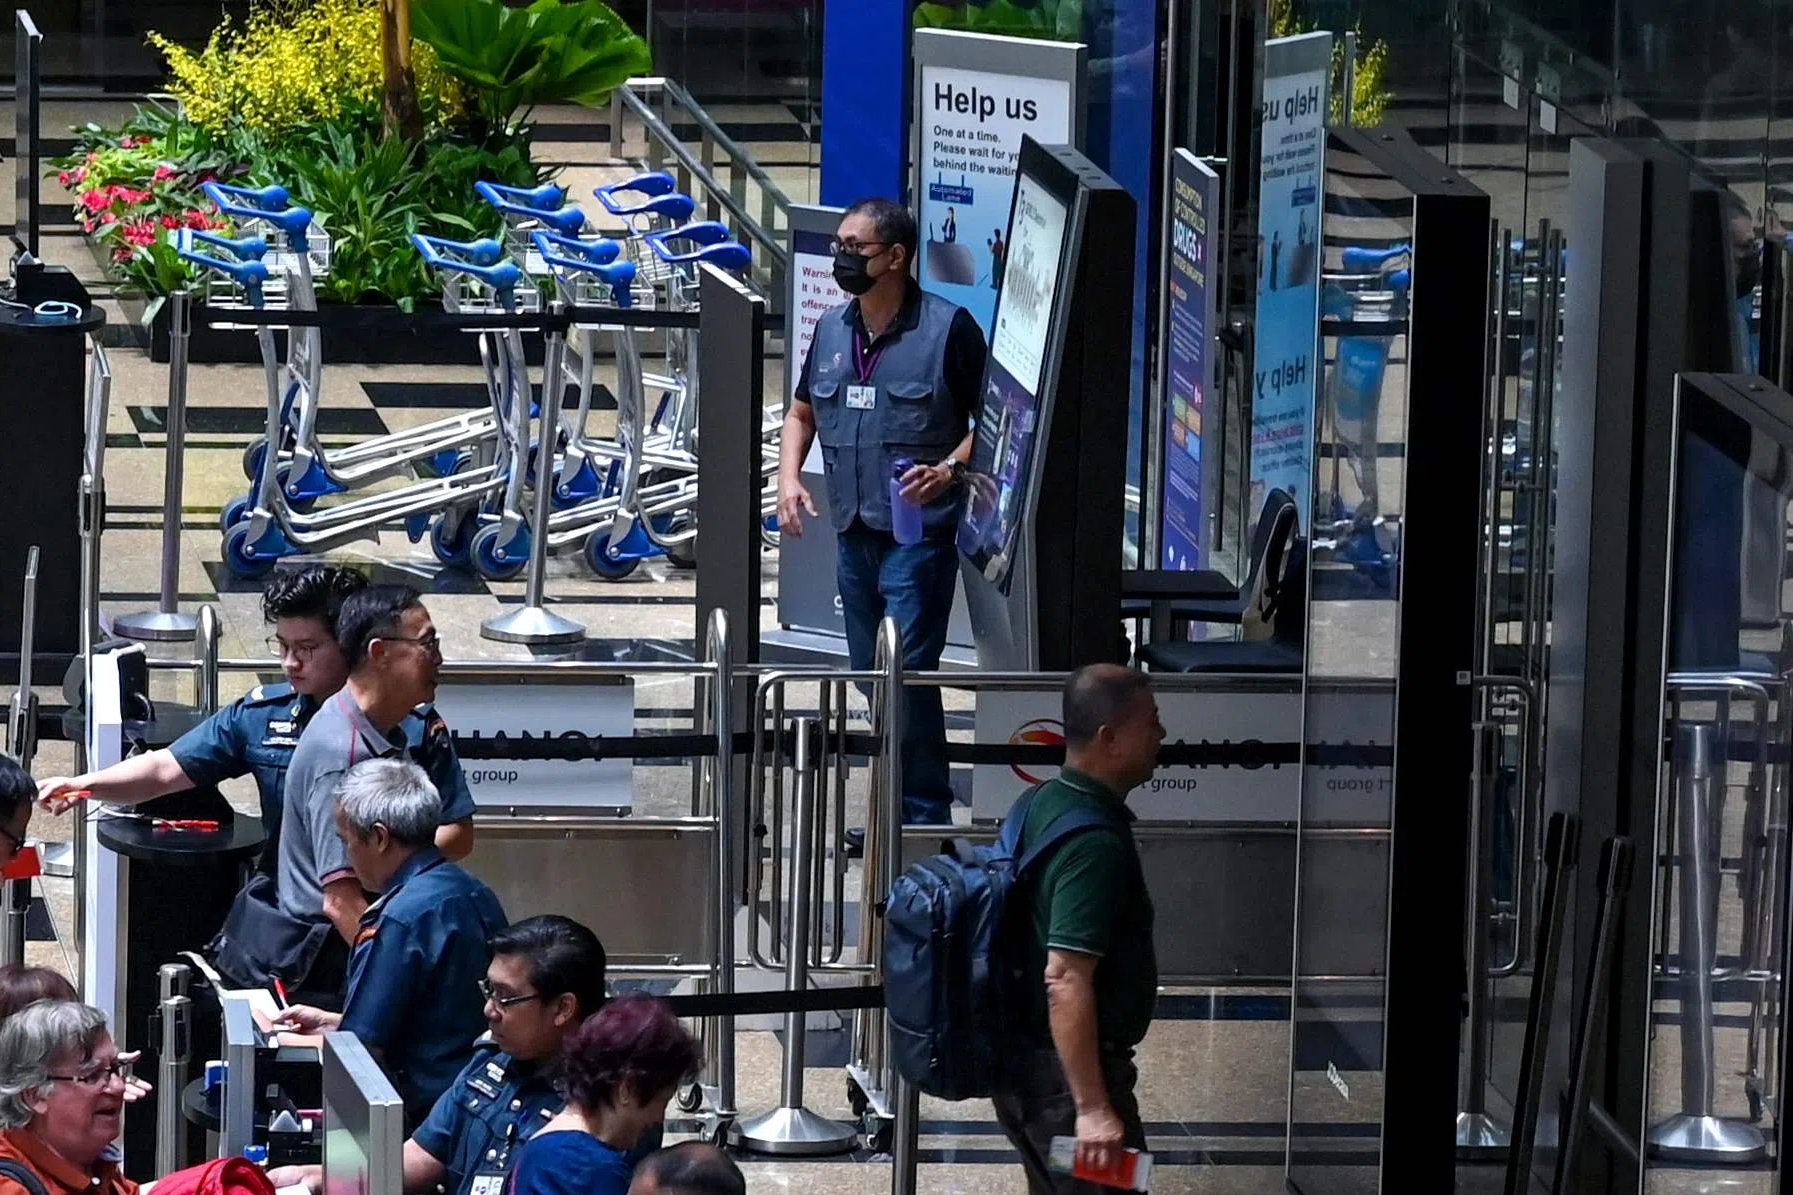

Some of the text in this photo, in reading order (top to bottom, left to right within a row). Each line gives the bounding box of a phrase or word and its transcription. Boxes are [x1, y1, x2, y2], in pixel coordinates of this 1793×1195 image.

[934, 82, 1038, 123] Help us
[933, 125, 1001, 143] One at a time.
[933, 141, 966, 155] Please
[969, 146, 989, 158] wait
[992, 147, 1006, 160] for
[933, 157, 967, 172] behind
[969, 161, 985, 173] the
[1173, 217, 1197, 263] DRUGS
[813, 283, 821, 294] is
[472, 769, 518, 784] group
[1151, 777, 1197, 793] group
